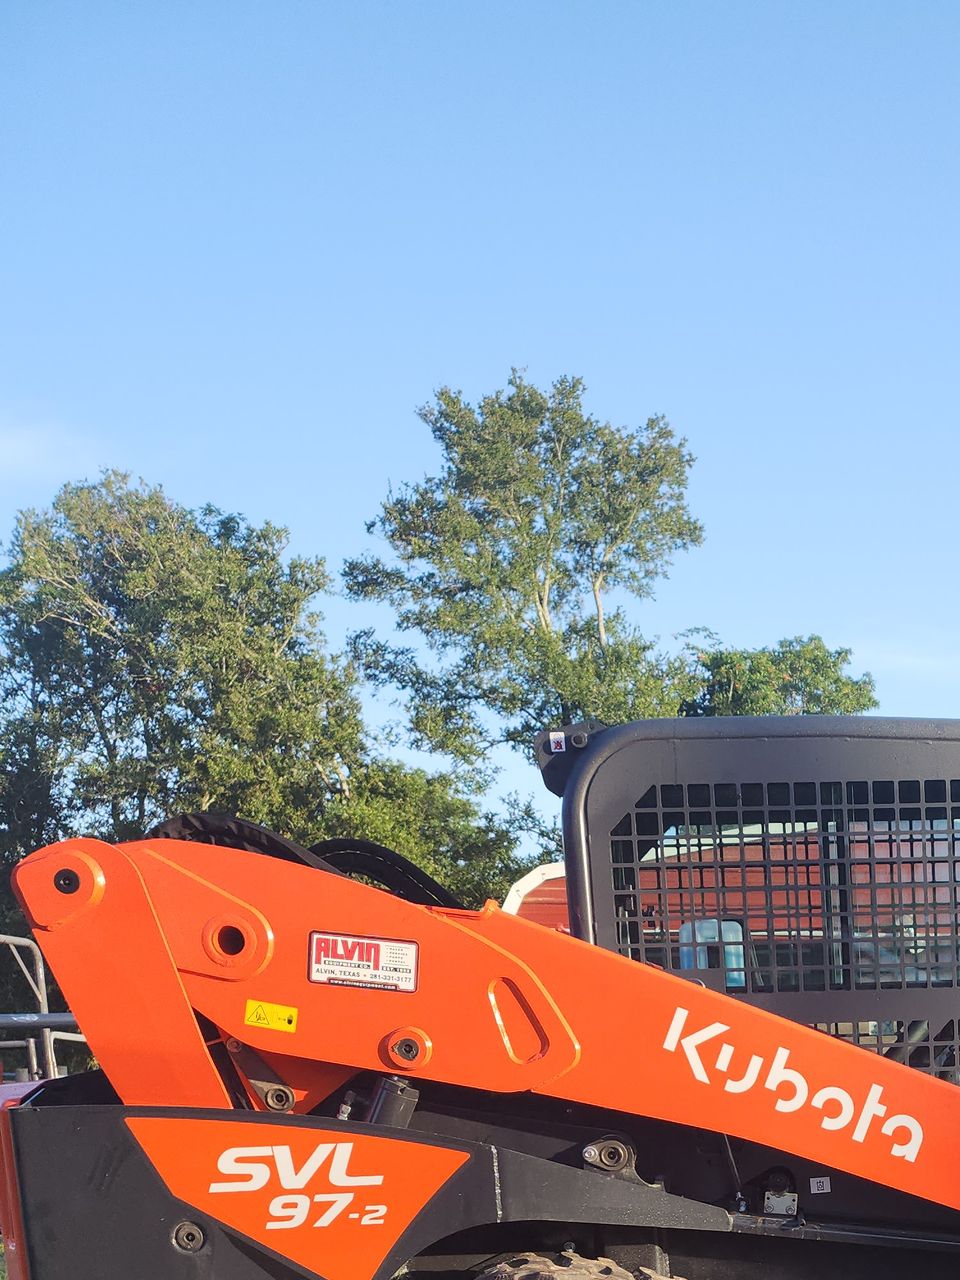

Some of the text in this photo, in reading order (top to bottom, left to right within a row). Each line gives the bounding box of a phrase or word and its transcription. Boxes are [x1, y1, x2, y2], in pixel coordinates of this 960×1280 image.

[315, 938, 380, 970] ALVIN
[316, 968, 337, 976] ALVIN,
[662, 1006, 924, 1163] Kubota
[208, 1143, 384, 1193] SVL
[266, 1193, 387, 1229] 97-2
